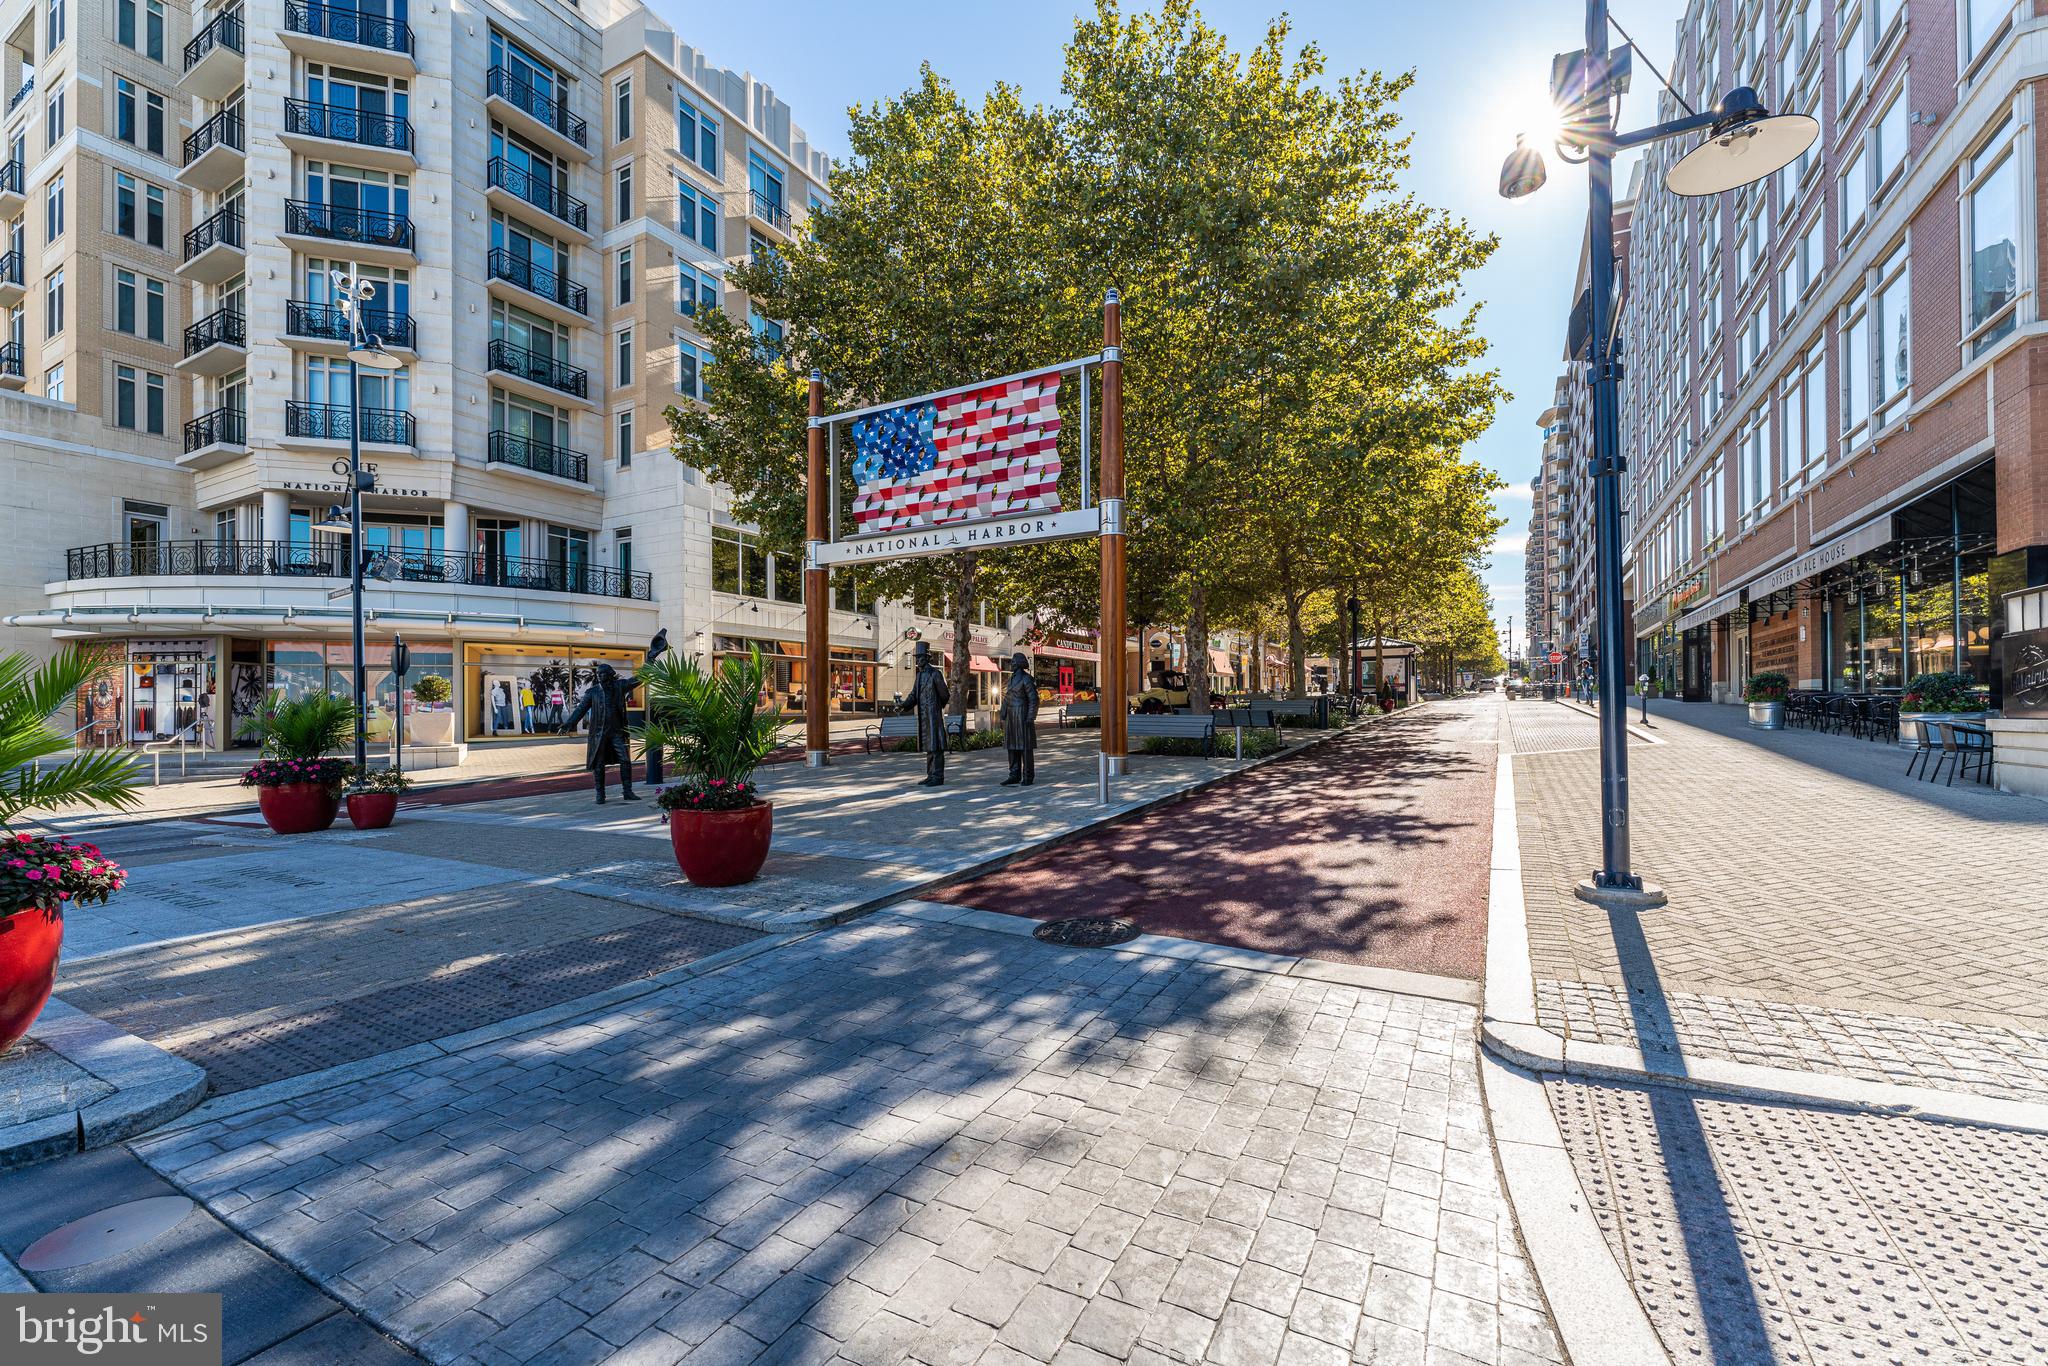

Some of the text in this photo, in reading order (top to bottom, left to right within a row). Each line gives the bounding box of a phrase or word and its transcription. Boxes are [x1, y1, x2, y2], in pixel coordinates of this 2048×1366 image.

[332, 457, 380, 481] OE
[283, 482, 429, 497] NATIONA HARBOR
[855, 521, 1045, 555] NATIONAL HARBOR
[1771, 543, 1846, 588] OYSTER & ALE HOUSE
[1056, 638, 1094, 652] CANDY KITCHEN
[2014, 669, 2048, 690] Walru
